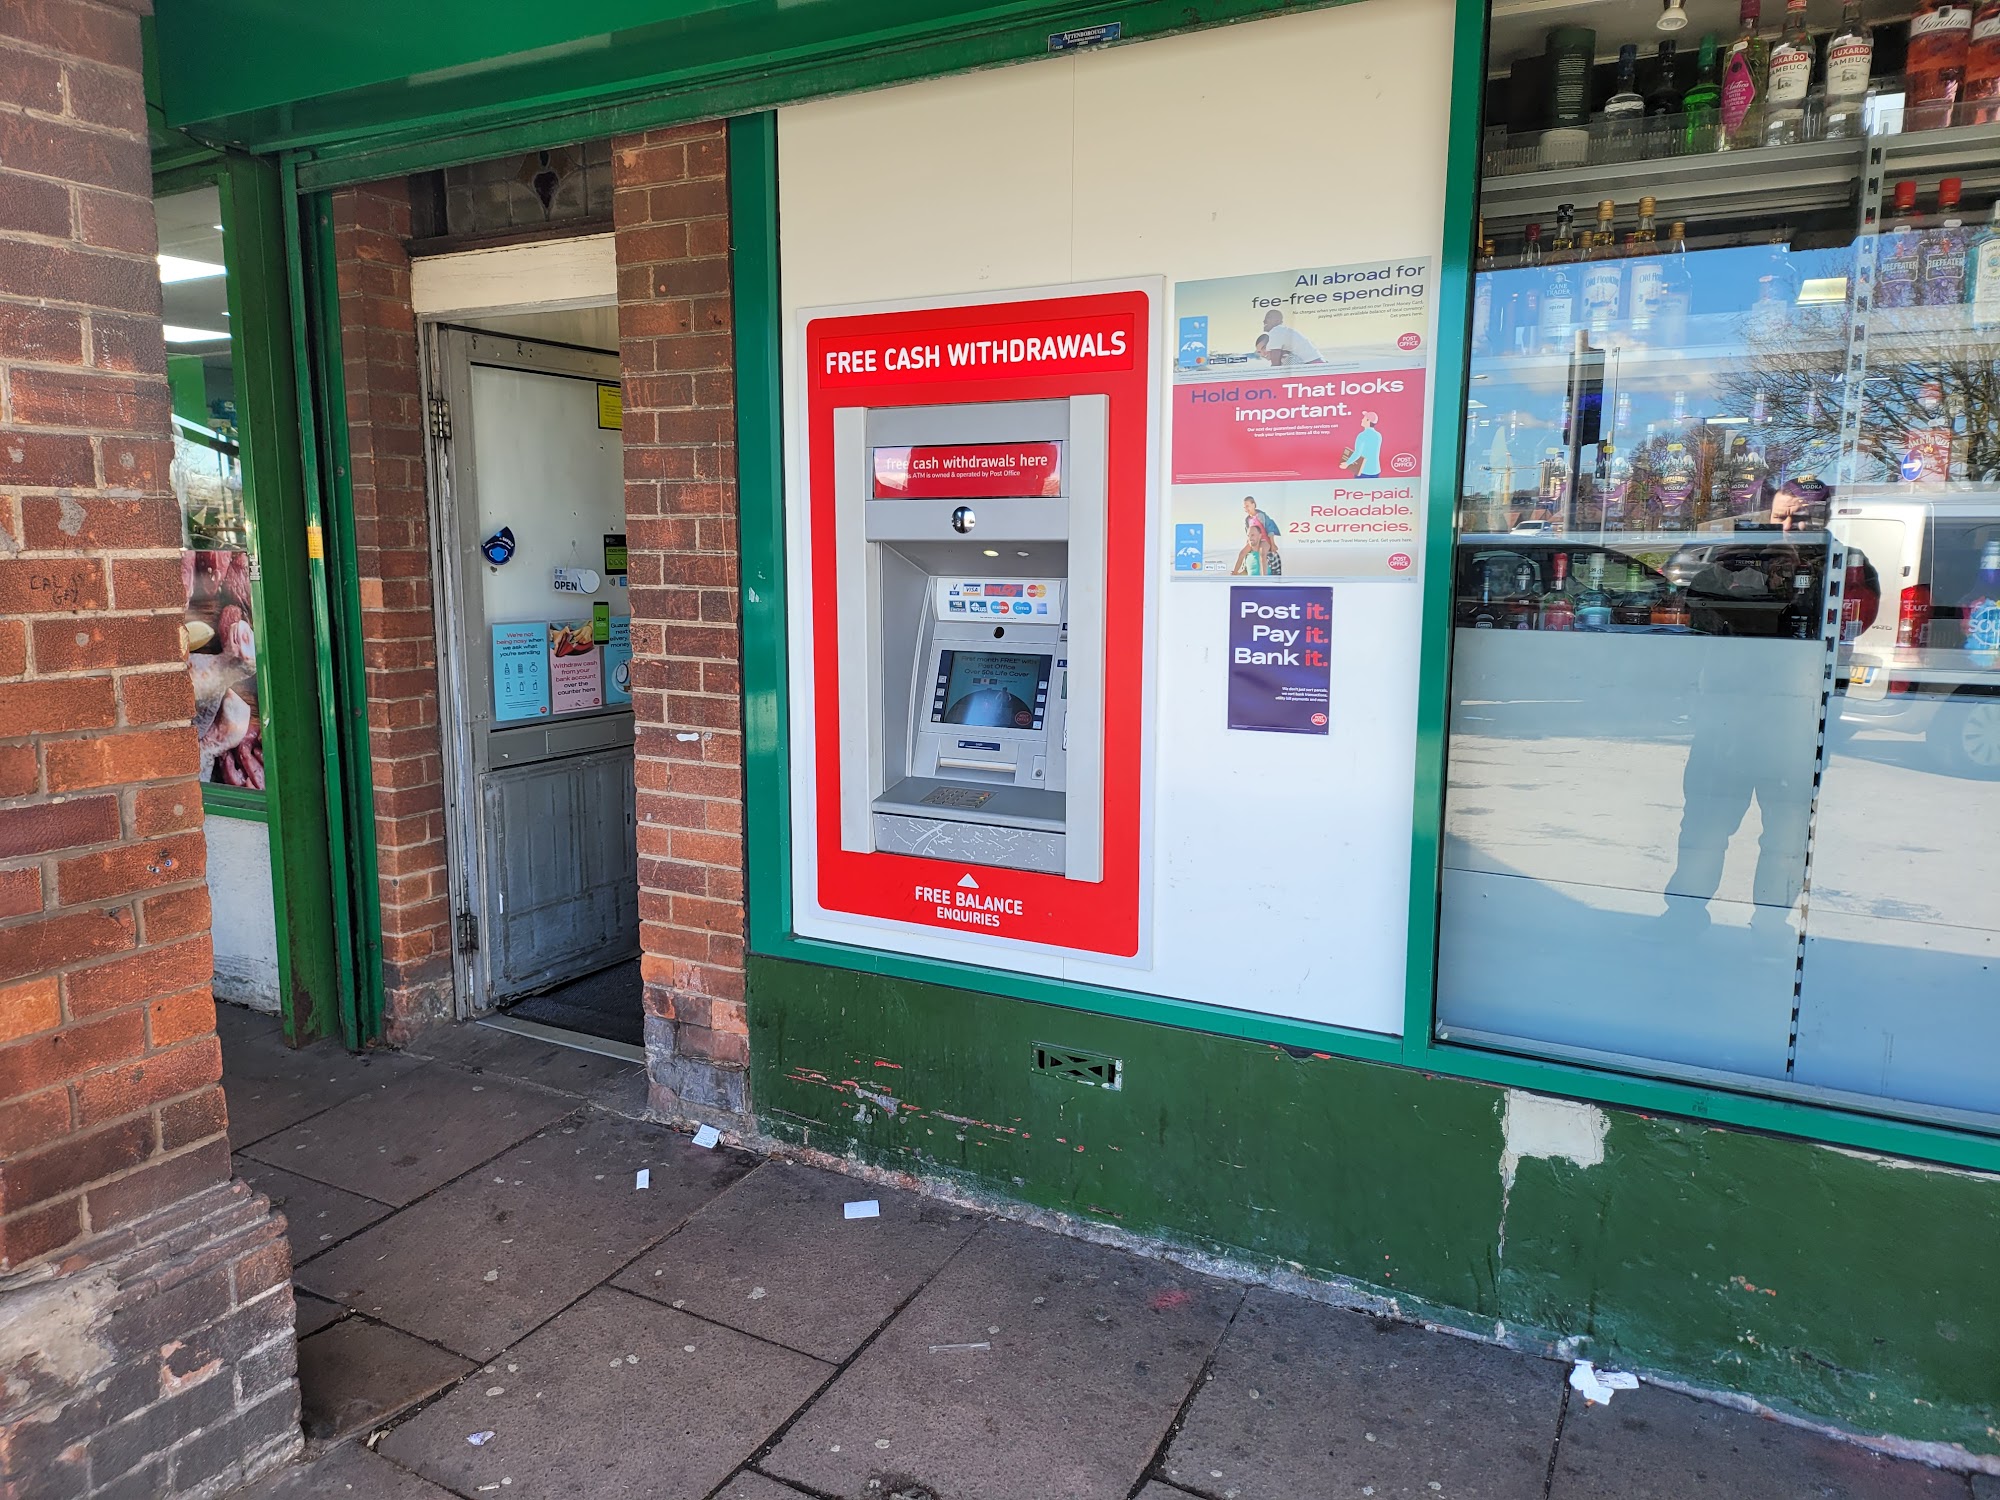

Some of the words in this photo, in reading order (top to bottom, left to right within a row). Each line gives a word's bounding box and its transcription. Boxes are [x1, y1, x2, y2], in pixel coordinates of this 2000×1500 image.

[1063, 28, 1106, 40] ATTENBOROUGH
[1833, 46, 1870, 58] LUXARDO
[1771, 54, 1805, 66] LUXARDO
[1829, 56, 1871, 69] SAMBUCA
[1881, 261, 1918, 272] BEEFEATER
[1927, 257, 1965, 269] BEEFEATER
[1295, 274, 1318, 288] All
[1322, 266, 1391, 285] abroad
[1396, 264, 1425, 277] for
[1549, 283, 1568, 291] CANE
[1251, 292, 1328, 309] fee-free
[1332, 282, 1424, 304] spending
[826, 349, 877, 374] FREE
[884, 345, 940, 371] CASH
[948, 330, 1127, 367] WITHDRAWALS
[1191, 388, 1240, 404] Hold
[1245, 386, 1277, 401] on.
[1282, 382, 1336, 400] That
[1340, 378, 1405, 395] looks
[1235, 402, 1353, 424] important.
[887, 458, 909, 470] free
[913, 457, 939, 469] cash
[943, 454, 1016, 469] withdrawals
[1020, 454, 1048, 466] here
[956, 471, 981, 479] operated
[981, 470, 988, 478] by
[1334, 488, 1414, 502] Pre-paid.
[1310, 504, 1414, 517] Reloadable.
[1289, 522, 1311, 533] 23
[1315, 520, 1413, 533] currencies.
[554, 580, 578, 591] OPEN
[1241, 601, 1300, 620] Post
[1306, 602, 1329, 620] it.
[1252, 625, 1300, 647] Pay
[1305, 626, 1329, 644] it.
[1234, 647, 1300, 666] Bank
[1305, 649, 1328, 667] it.
[915, 886, 951, 904] FREE
[955, 891, 1023, 916] BALANCE
[937, 906, 1000, 927] ENQUIRIES
